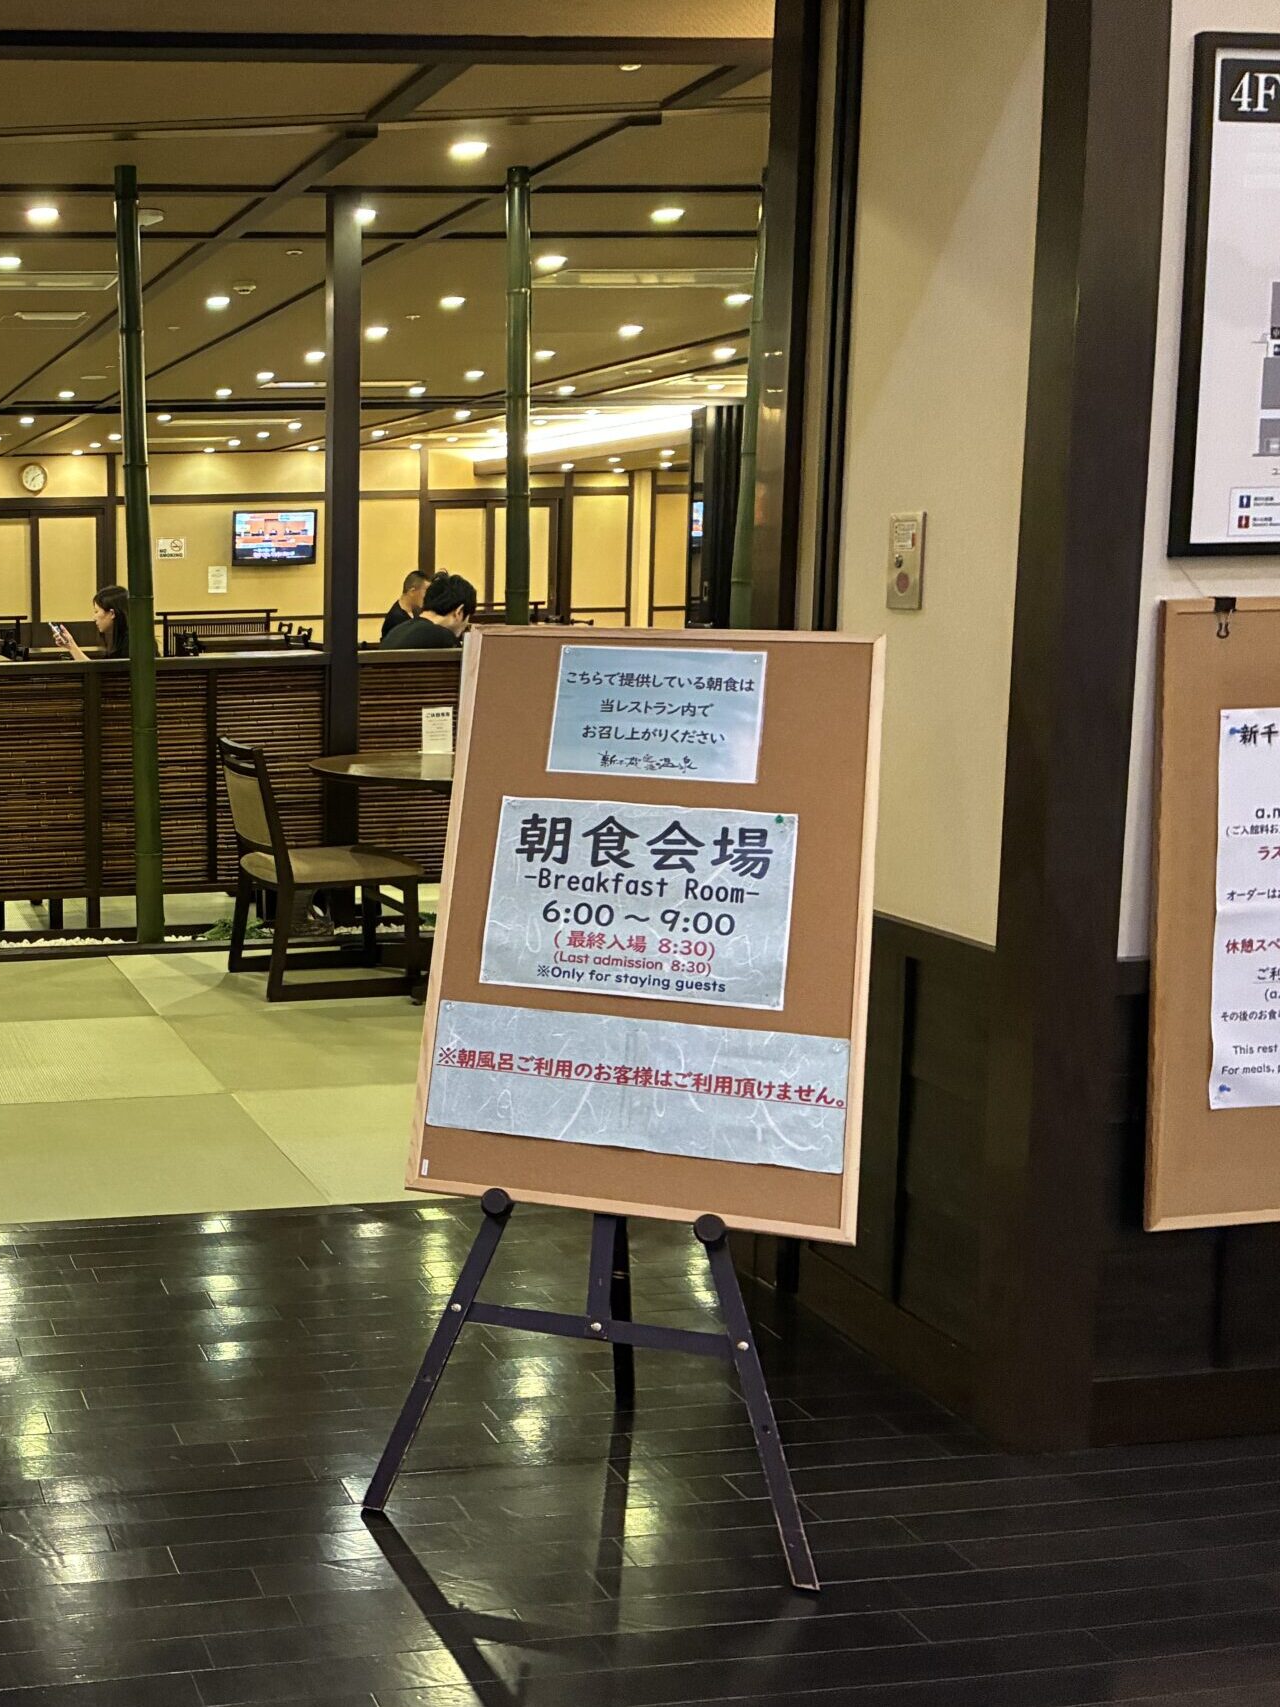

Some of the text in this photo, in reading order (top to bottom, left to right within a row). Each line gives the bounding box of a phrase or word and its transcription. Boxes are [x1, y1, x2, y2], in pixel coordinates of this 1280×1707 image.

[1231, 71, 1280, 112] 4F
[566, 671, 755, 692] こちらで提供している朝食は
[599, 698, 715, 718] 当レストラン内で
[582, 725, 726, 745] お召し上がりください
[1240, 723, 1279, 744] 新千
[515, 812, 774, 880] 朝食会場
[657, 938, 716, 961] 8:30)
[553, 951, 712, 977] (Last admission 8:30)
[588, 969, 611, 982] for
[614, 973, 671, 991] staying
[675, 978, 726, 994] guests
[1221, 1009, 1280, 1023] その後のお食
[1232, 1043, 1278, 1055] This rest
[437, 1046, 847, 1108] ※朝風呂ご利用のお客様はご利用頂けません。
[1221, 1065, 1240, 1075] For
[1242, 1062, 1275, 1075] meals,
